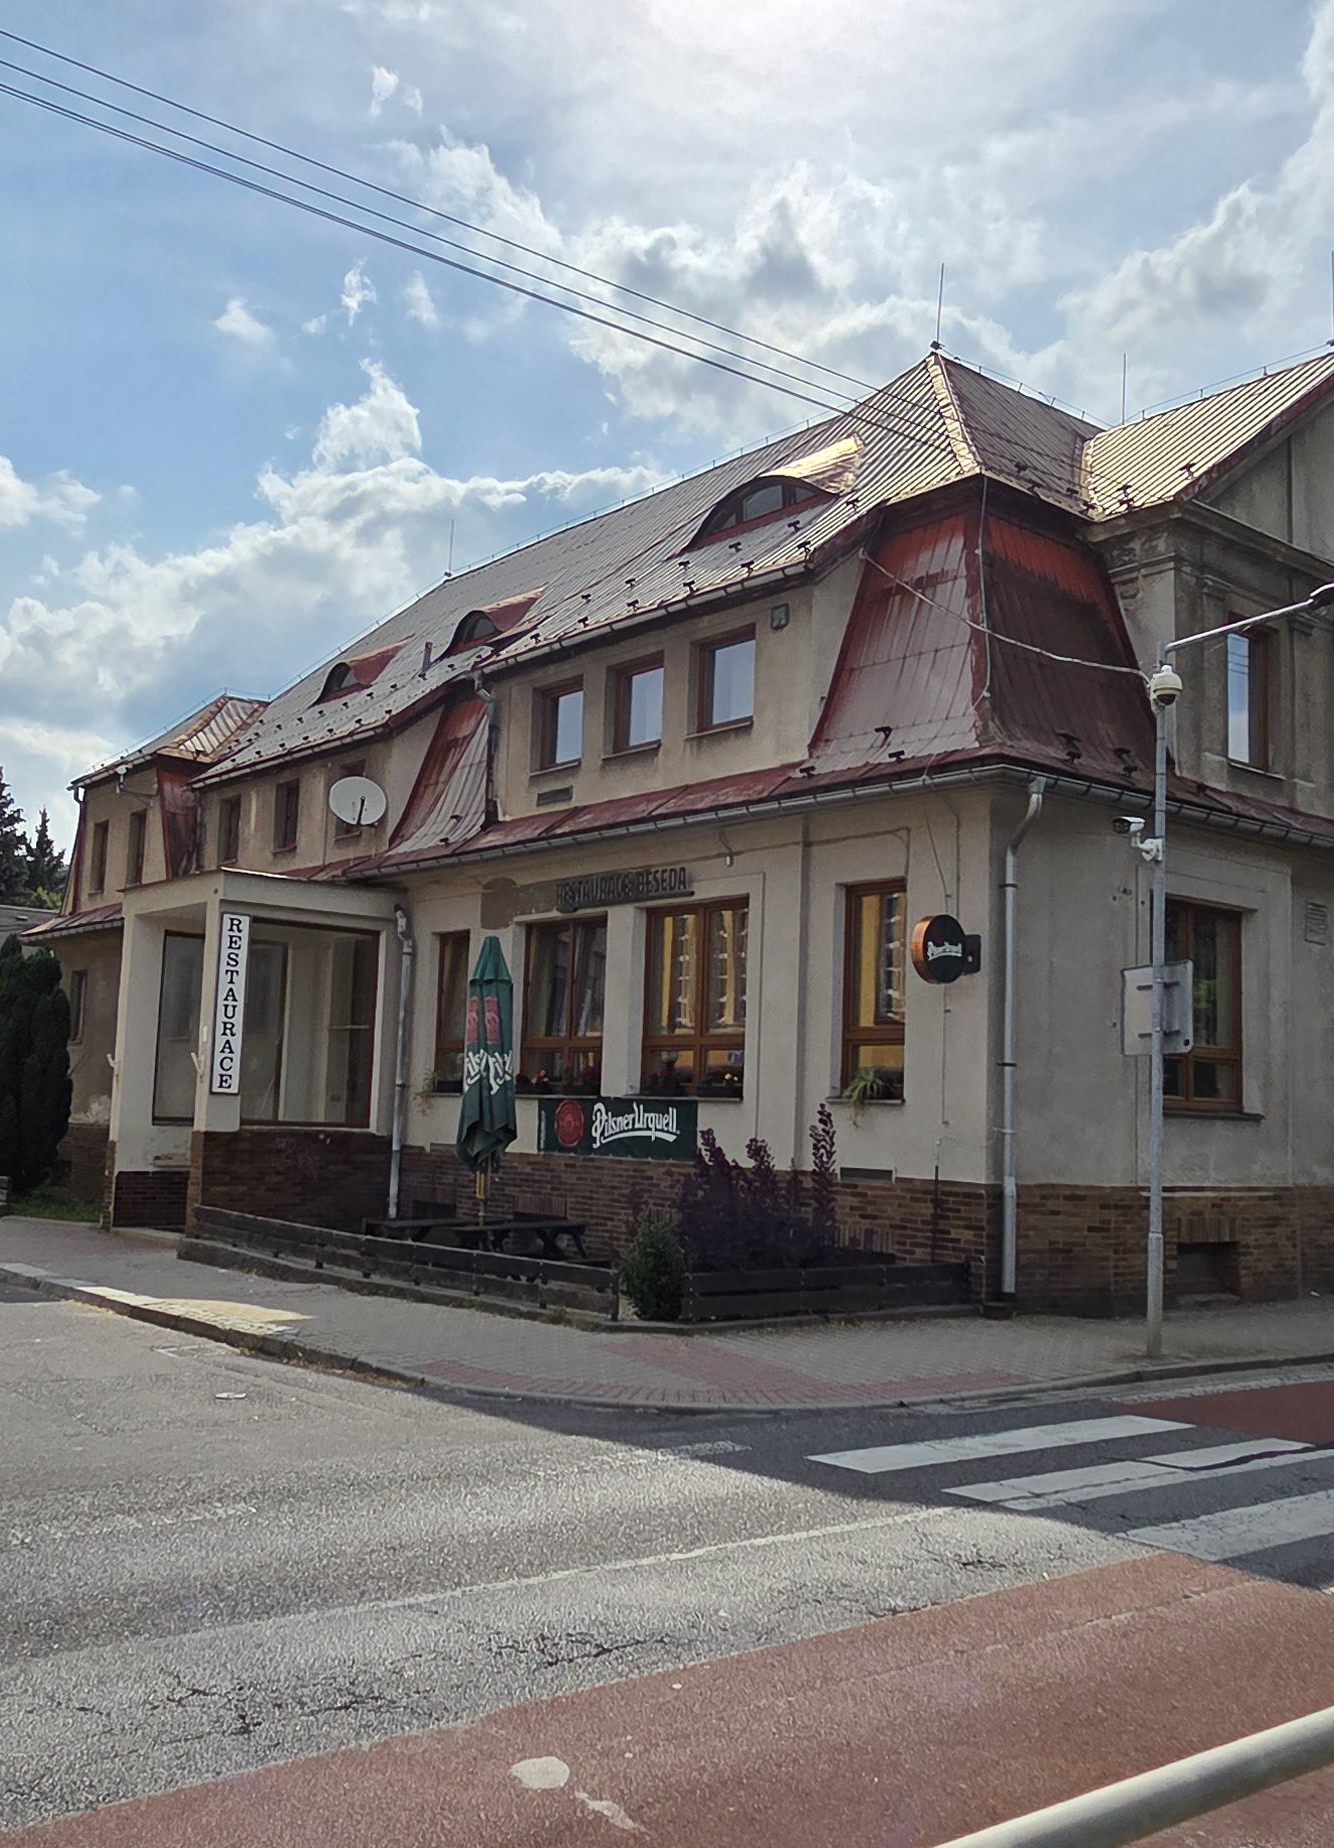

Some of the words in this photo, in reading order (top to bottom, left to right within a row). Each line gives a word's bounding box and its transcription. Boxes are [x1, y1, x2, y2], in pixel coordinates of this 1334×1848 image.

[557, 873, 633, 905] RESTAURACE
[638, 867, 687, 894] BESEDA
[218, 917, 243, 1089] RESTAURACE
[592, 1102, 634, 1148] Pilsner
[632, 1101, 677, 1142] Urquell
